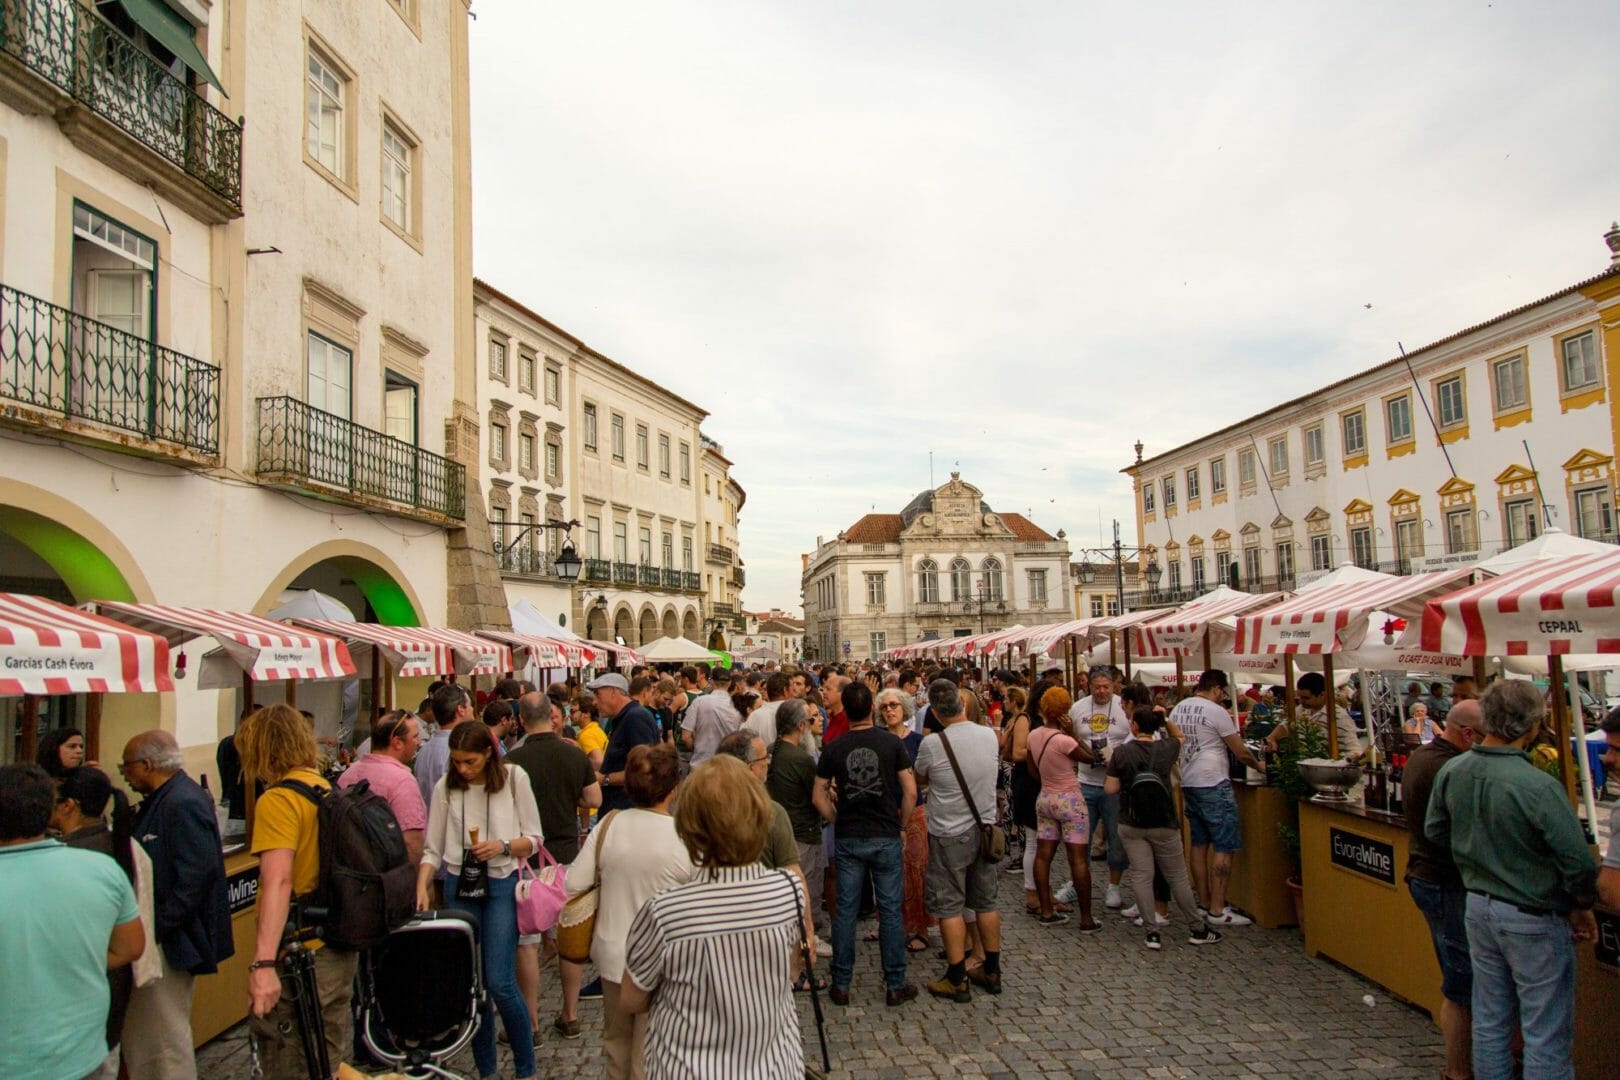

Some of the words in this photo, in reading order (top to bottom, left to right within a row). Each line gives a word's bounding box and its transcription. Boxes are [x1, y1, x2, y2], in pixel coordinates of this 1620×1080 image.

[1538, 620, 1583, 633] CEPAAL
[5, 656, 43, 669] Garcias
[45, 657, 68, 669] Cash
[69, 656, 94, 670] Évora
[1445, 656, 1462, 667] VIDA
[1081, 716, 1099, 725] Hard
[1099, 716, 1116, 726] Rock
[1333, 834, 1392, 871] ÉvoraWine
